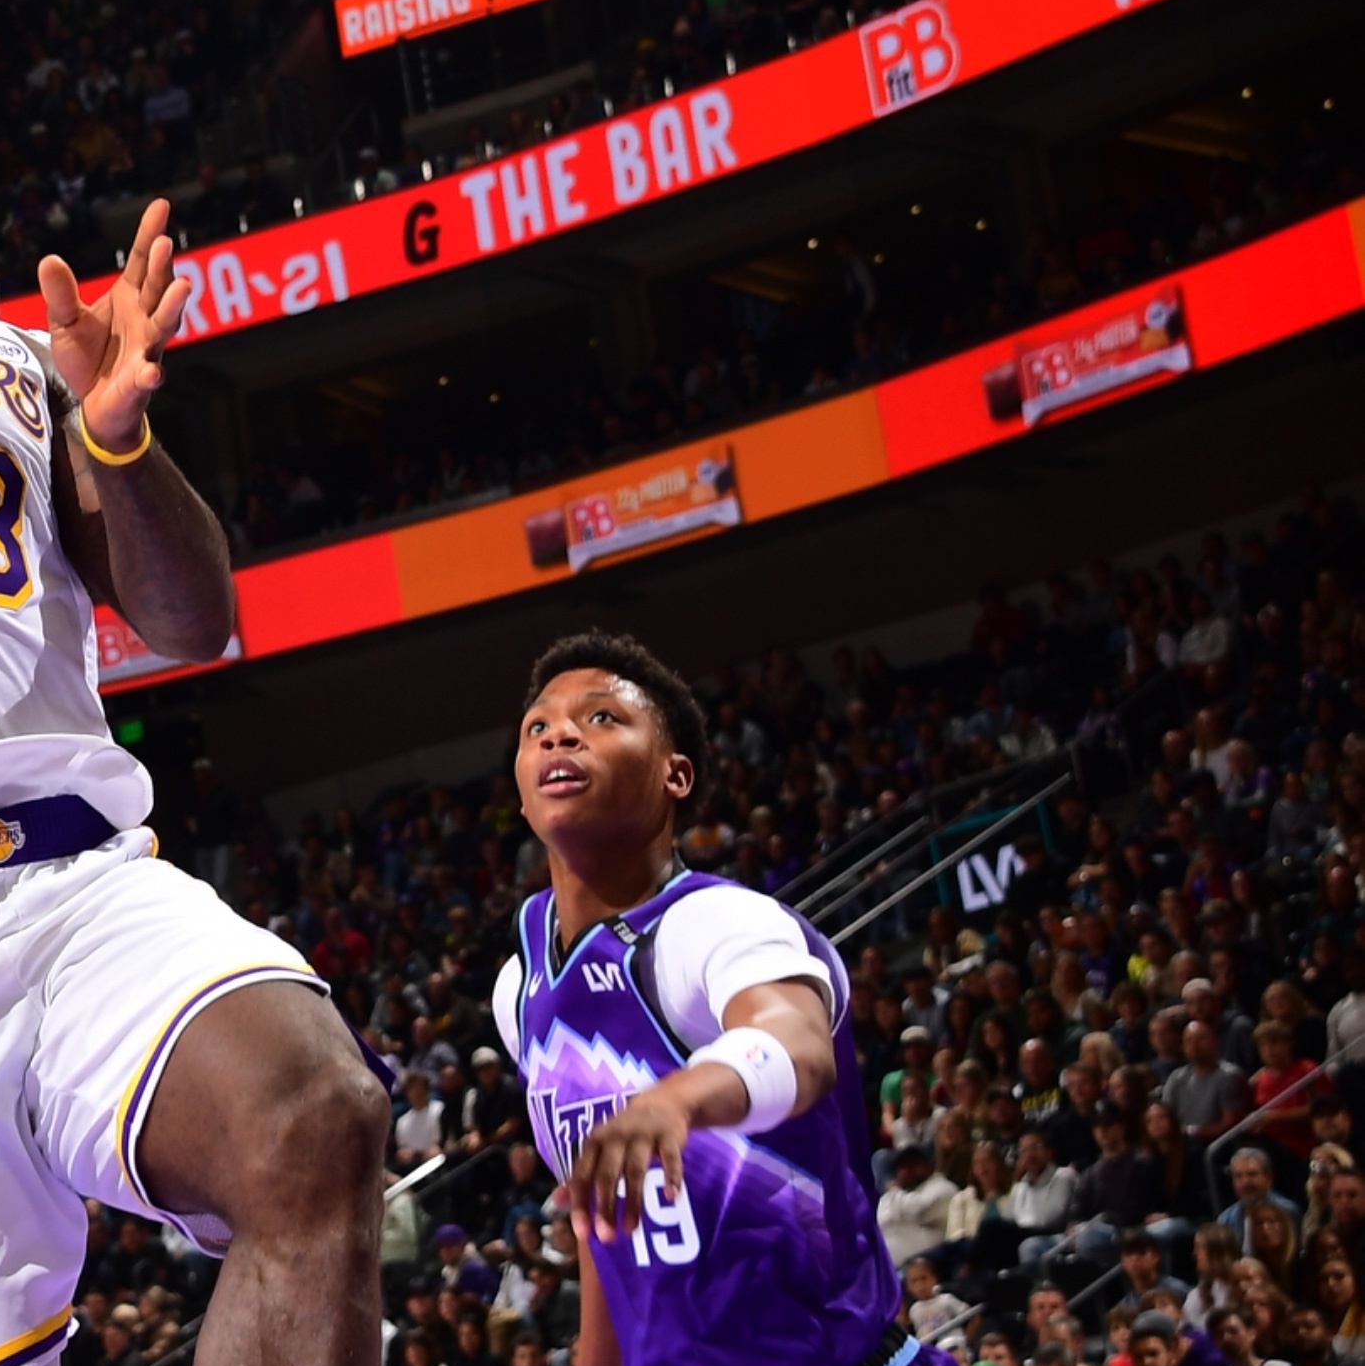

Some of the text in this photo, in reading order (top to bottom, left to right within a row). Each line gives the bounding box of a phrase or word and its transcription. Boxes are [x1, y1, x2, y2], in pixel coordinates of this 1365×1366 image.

[403, 200, 440, 266] G
[459, 139, 587, 253] THE
[605, 88, 739, 206] BAR
[616, 1166, 701, 1267] 19
